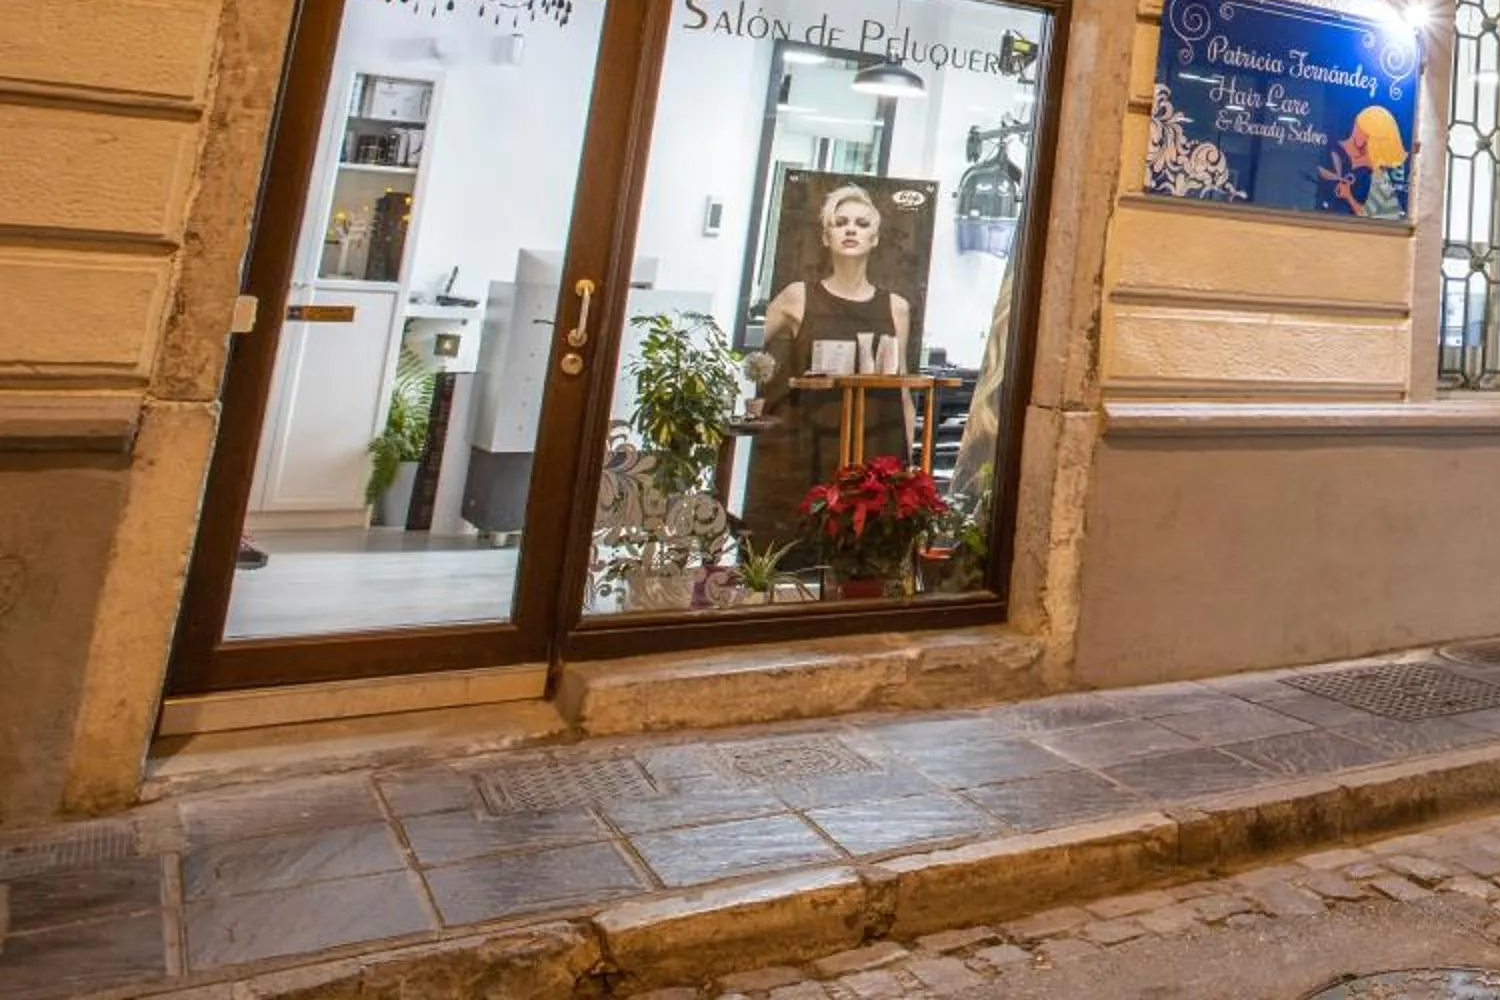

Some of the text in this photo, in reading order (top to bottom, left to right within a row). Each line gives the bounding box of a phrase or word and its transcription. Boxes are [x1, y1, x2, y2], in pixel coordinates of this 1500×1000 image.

[1207, 35, 1379, 97] Patricia Fernández
[1209, 74, 1311, 116] Hair Care
[1234, 112, 1286, 144] Beauty
